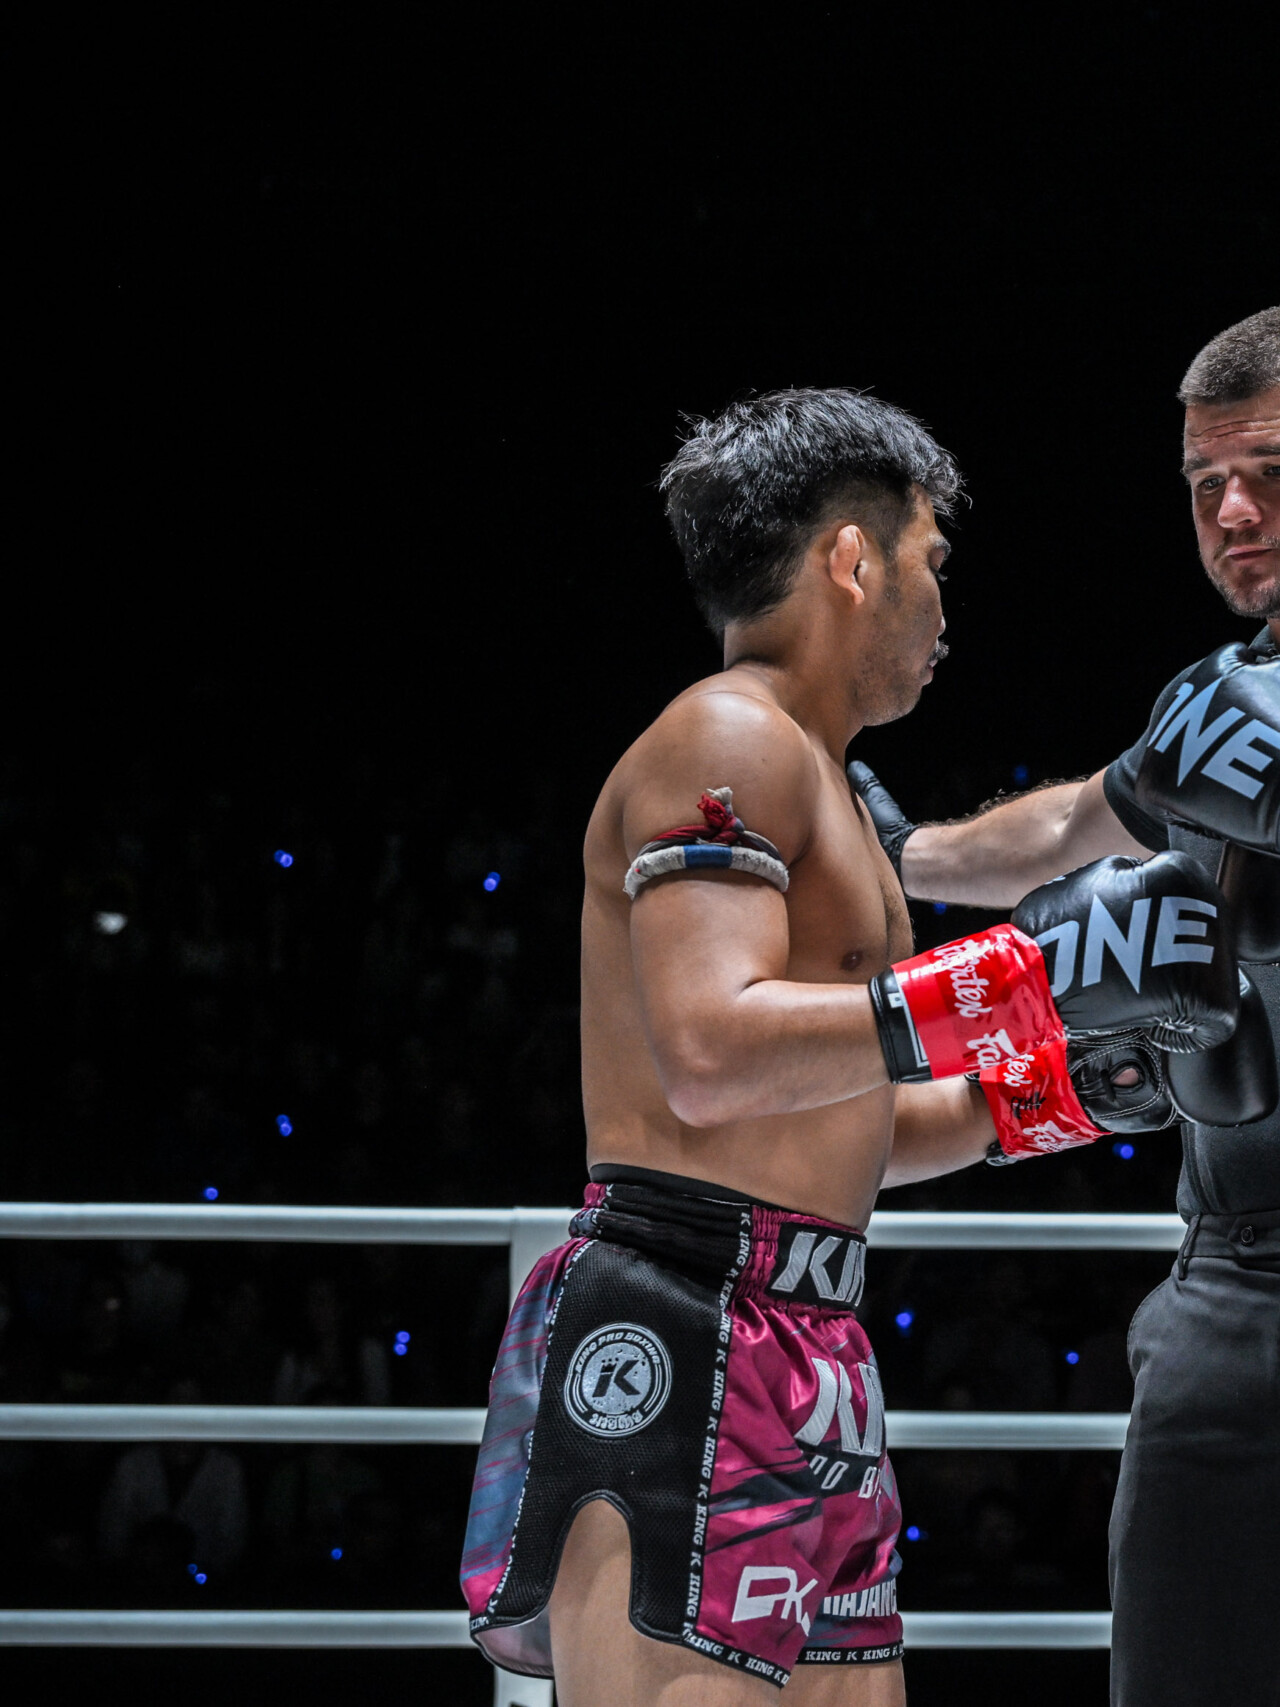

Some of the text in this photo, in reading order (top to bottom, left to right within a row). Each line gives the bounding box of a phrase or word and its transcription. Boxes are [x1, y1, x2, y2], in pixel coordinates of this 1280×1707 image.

[1034, 893, 1217, 998] ONE
[575, 1332, 660, 1373] KING PRO BOXING
[711, 1368, 725, 1411] KING
[701, 1436, 716, 1479] KING
[693, 1503, 708, 1546] KING
[686, 1572, 701, 1618] KING
[745, 1657, 775, 1676] KING
[805, 1650, 841, 1661] KING
[862, 1648, 890, 1660] KING
